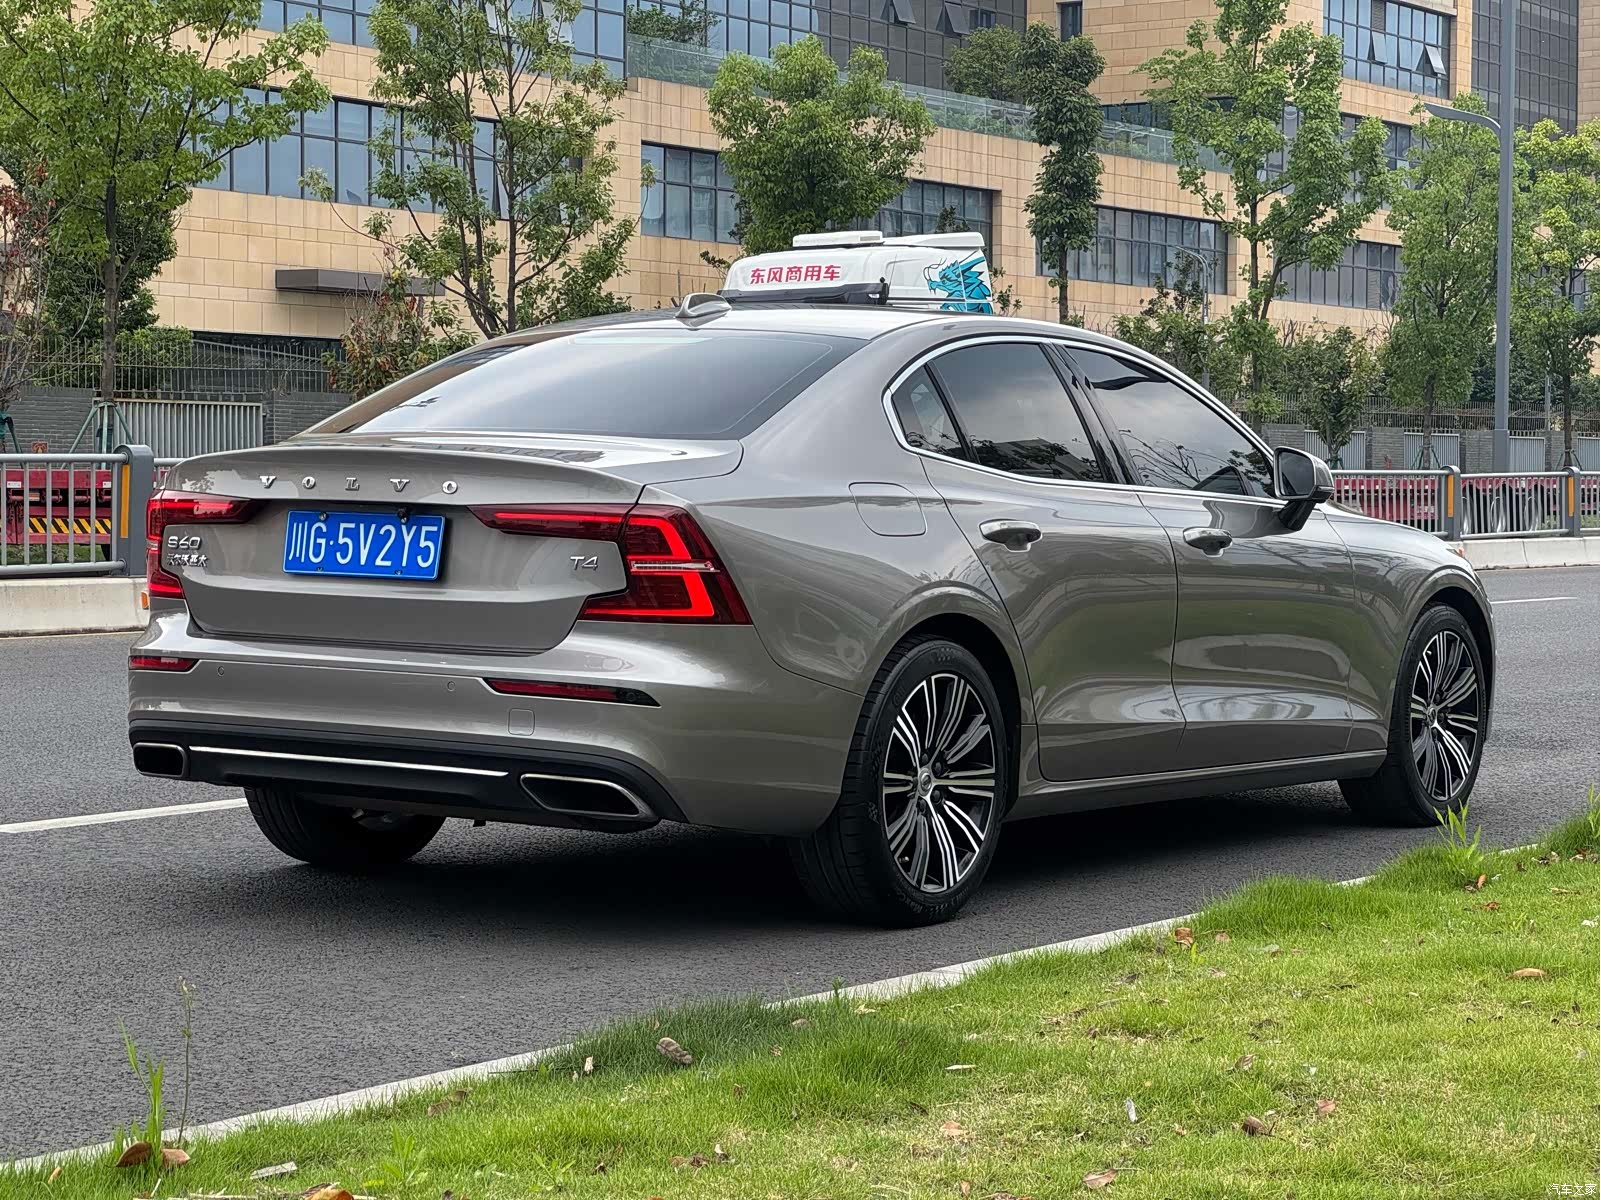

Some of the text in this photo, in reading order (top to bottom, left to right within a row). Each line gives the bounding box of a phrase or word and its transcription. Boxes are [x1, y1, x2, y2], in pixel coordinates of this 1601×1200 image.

[749, 264, 842, 285] 东风商用车
[259, 475, 459, 495] VOLVO
[167, 535, 202, 550] S60
[288, 520, 439, 568] 川G·5V2Y5
[569, 555, 599, 571] T4
